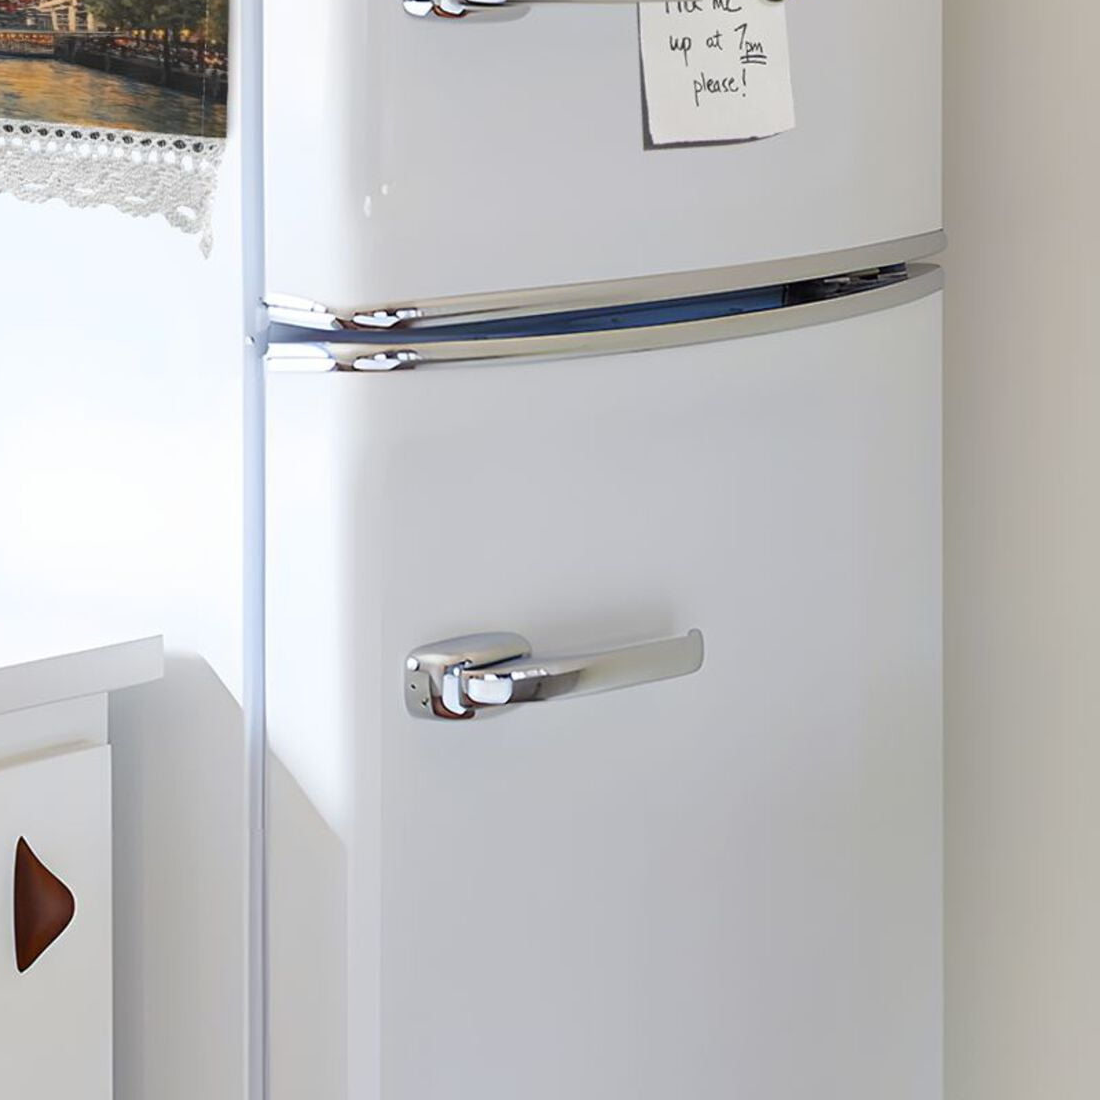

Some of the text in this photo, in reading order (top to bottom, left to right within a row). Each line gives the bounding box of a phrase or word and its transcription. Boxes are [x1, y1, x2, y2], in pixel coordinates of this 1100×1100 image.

[669, 35, 693, 67] up
[705, 29, 724, 51] at
[692, 66, 747, 108] please!
